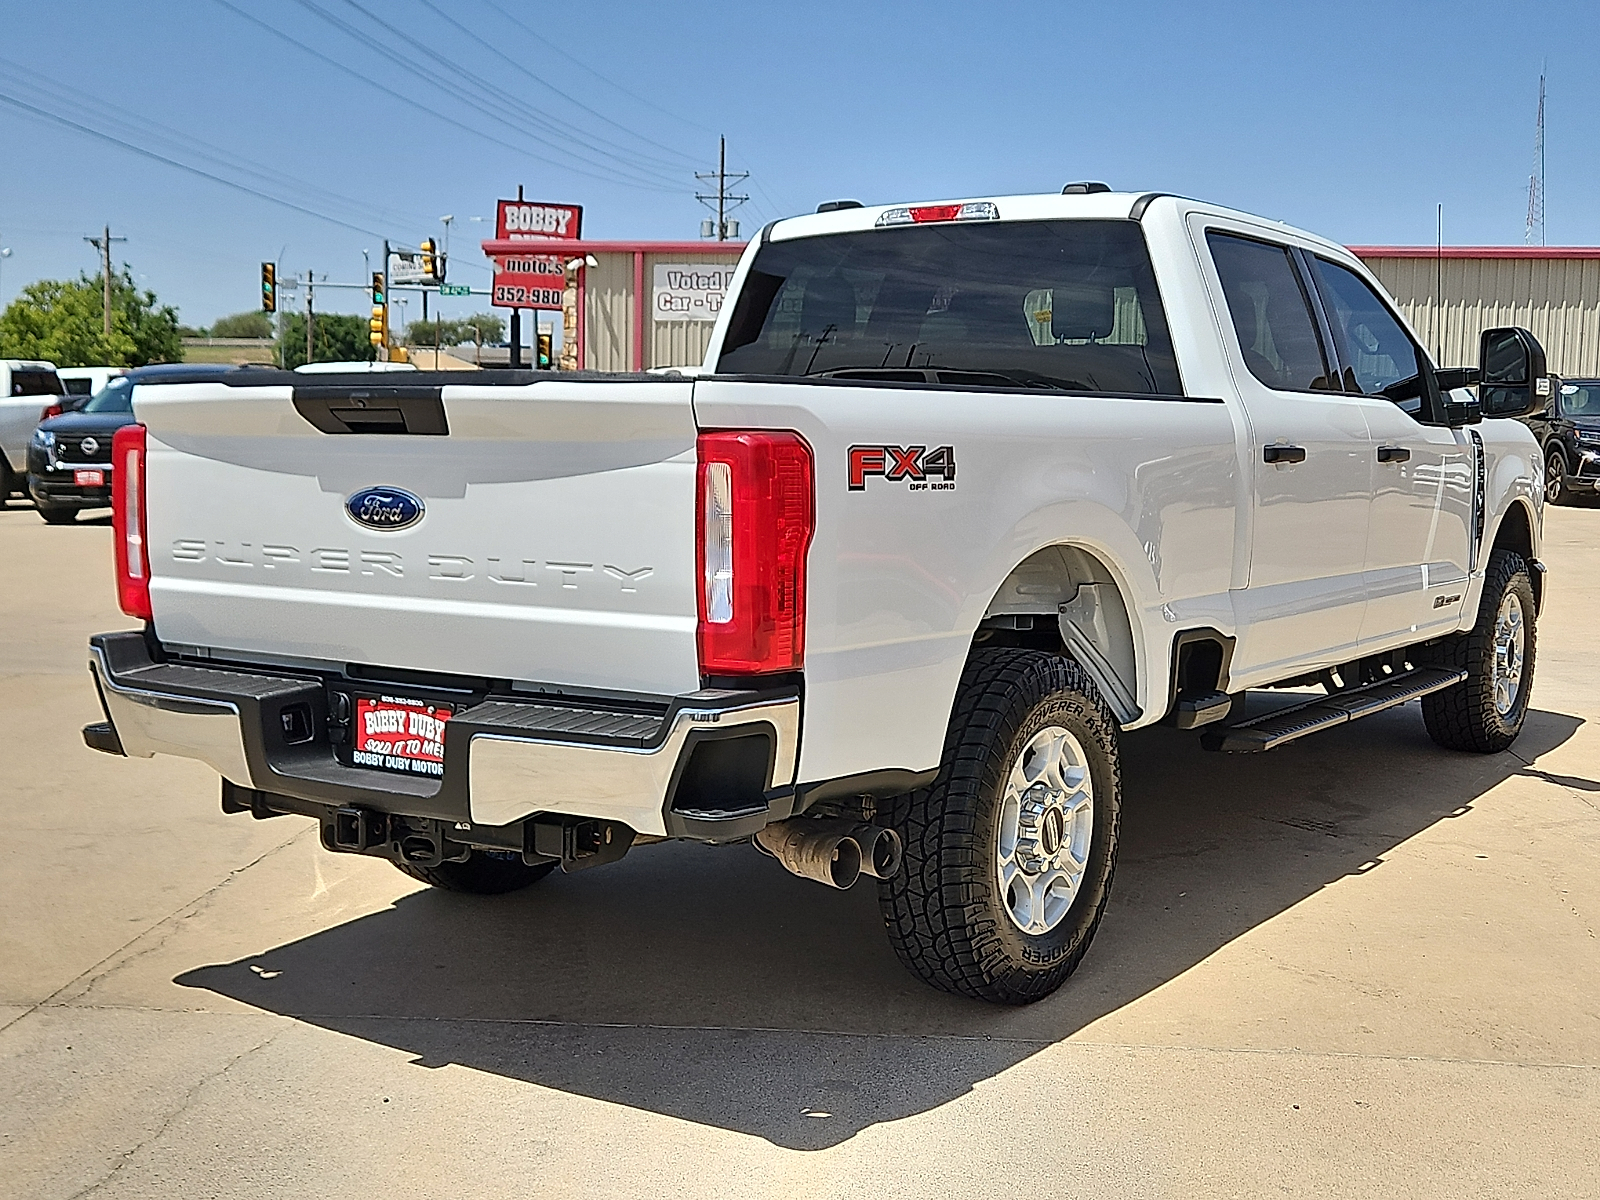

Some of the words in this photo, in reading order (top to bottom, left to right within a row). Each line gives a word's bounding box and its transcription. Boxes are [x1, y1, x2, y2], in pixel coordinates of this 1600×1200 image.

[505, 205, 572, 234] BOBBY
[668, 271, 722, 290] Voted
[496, 287, 564, 305] 352-980
[658, 293, 691, 312] Car
[847, 444, 956, 491] FX4
[909, 483, 928, 491] OFF
[931, 483, 956, 491] ROAD
[360, 493, 404, 524] Ford
[172, 538, 404, 578] SUPER
[428, 553, 655, 594] DUTY
[364, 709, 406, 735] BOBBY
[408, 711, 446, 743] DUBY
[364, 738, 392, 754] SOLD
[393, 740, 406, 756] IT
[405, 739, 421, 755] TO
[353, 751, 385, 767] BOBBY
[385, 755, 411, 771] DUBY
